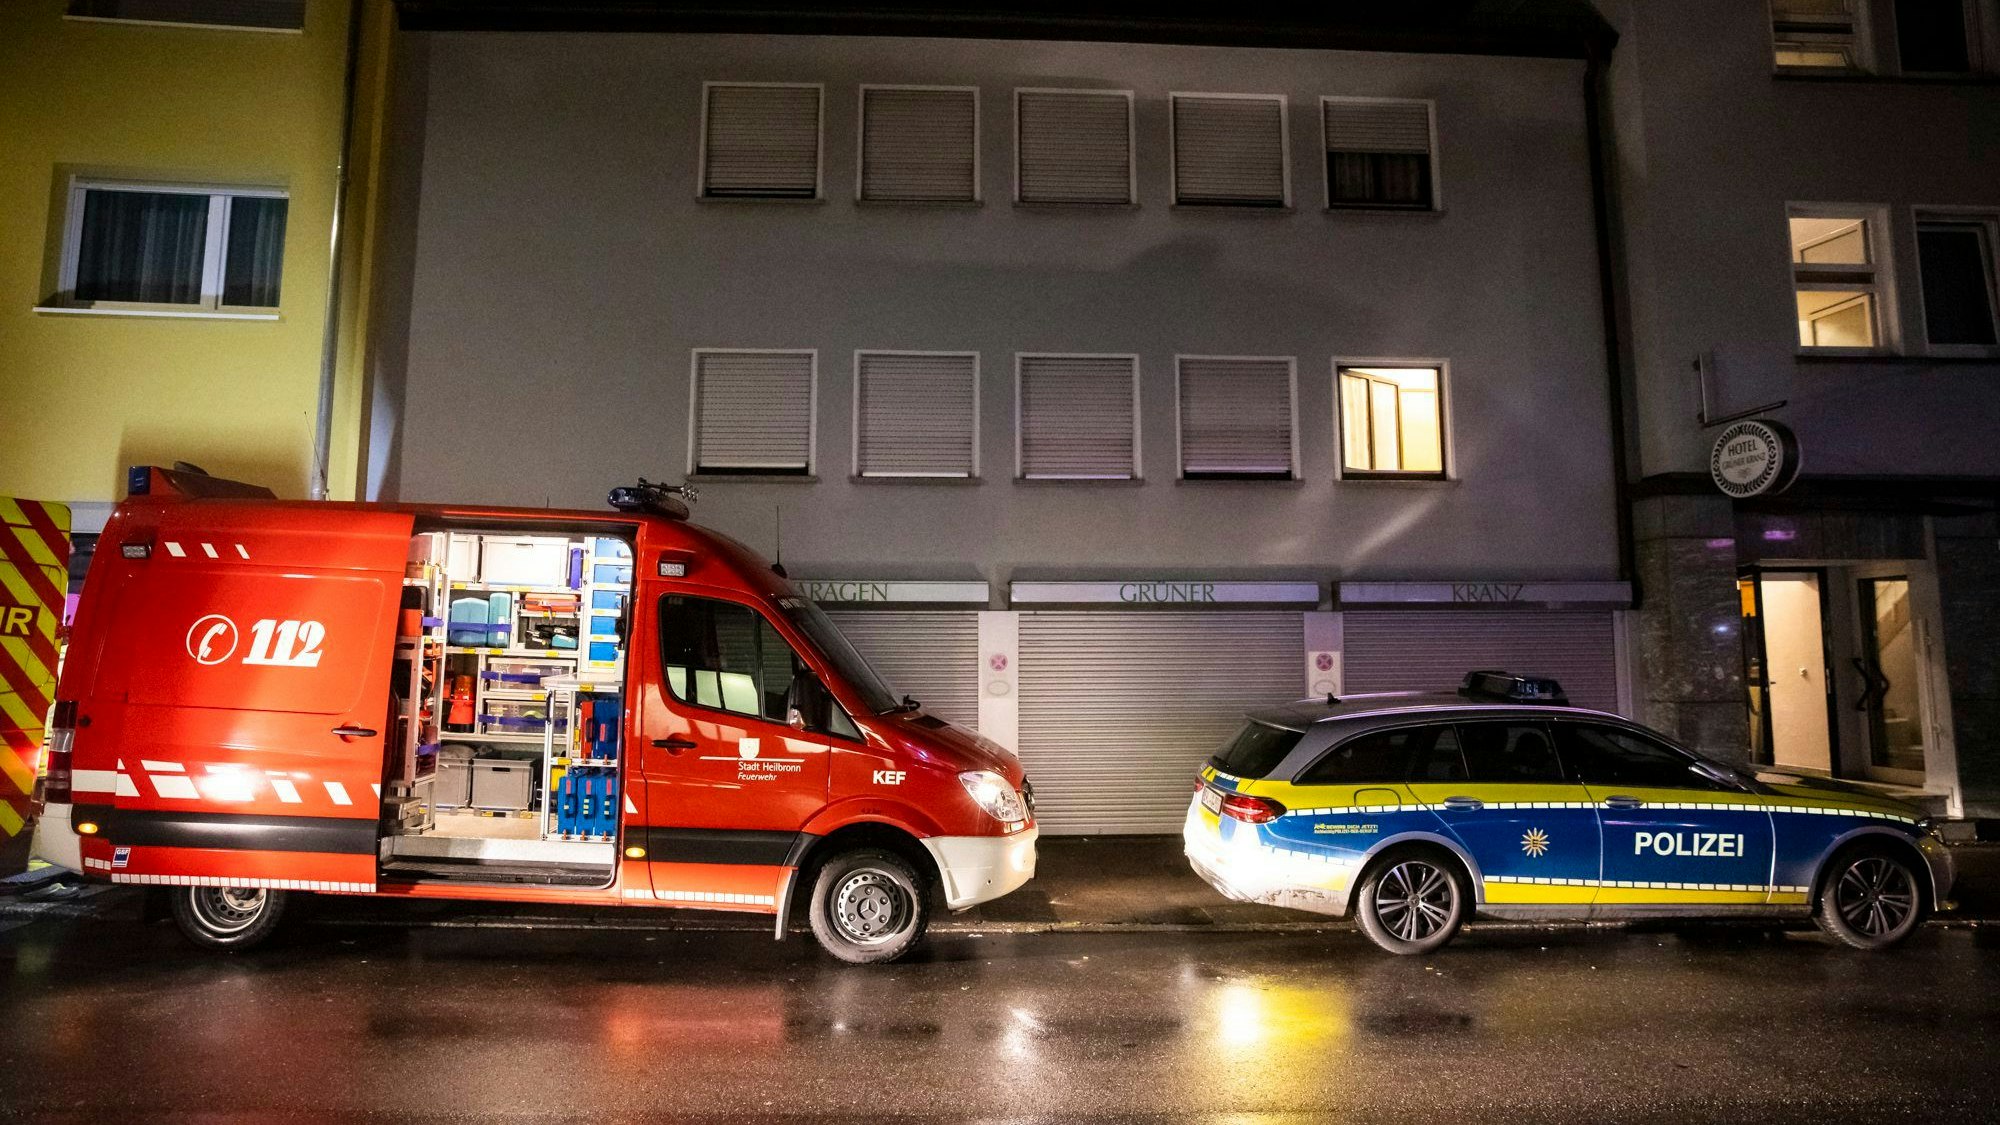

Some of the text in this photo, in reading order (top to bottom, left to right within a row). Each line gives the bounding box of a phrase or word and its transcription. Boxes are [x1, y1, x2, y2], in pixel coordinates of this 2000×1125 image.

[1728, 439, 1757, 456] HOTEL
[1120, 580, 1216, 602] GRÜNER
[1452, 583, 1524, 602] KRANZ
[241, 618, 326, 668] 112
[738, 761, 802, 772] Stadt Heilbronn
[737, 772, 778, 781] Feuerwehr
[872, 770, 907, 785] KEF
[1634, 831, 1744, 857] POLIZEI
